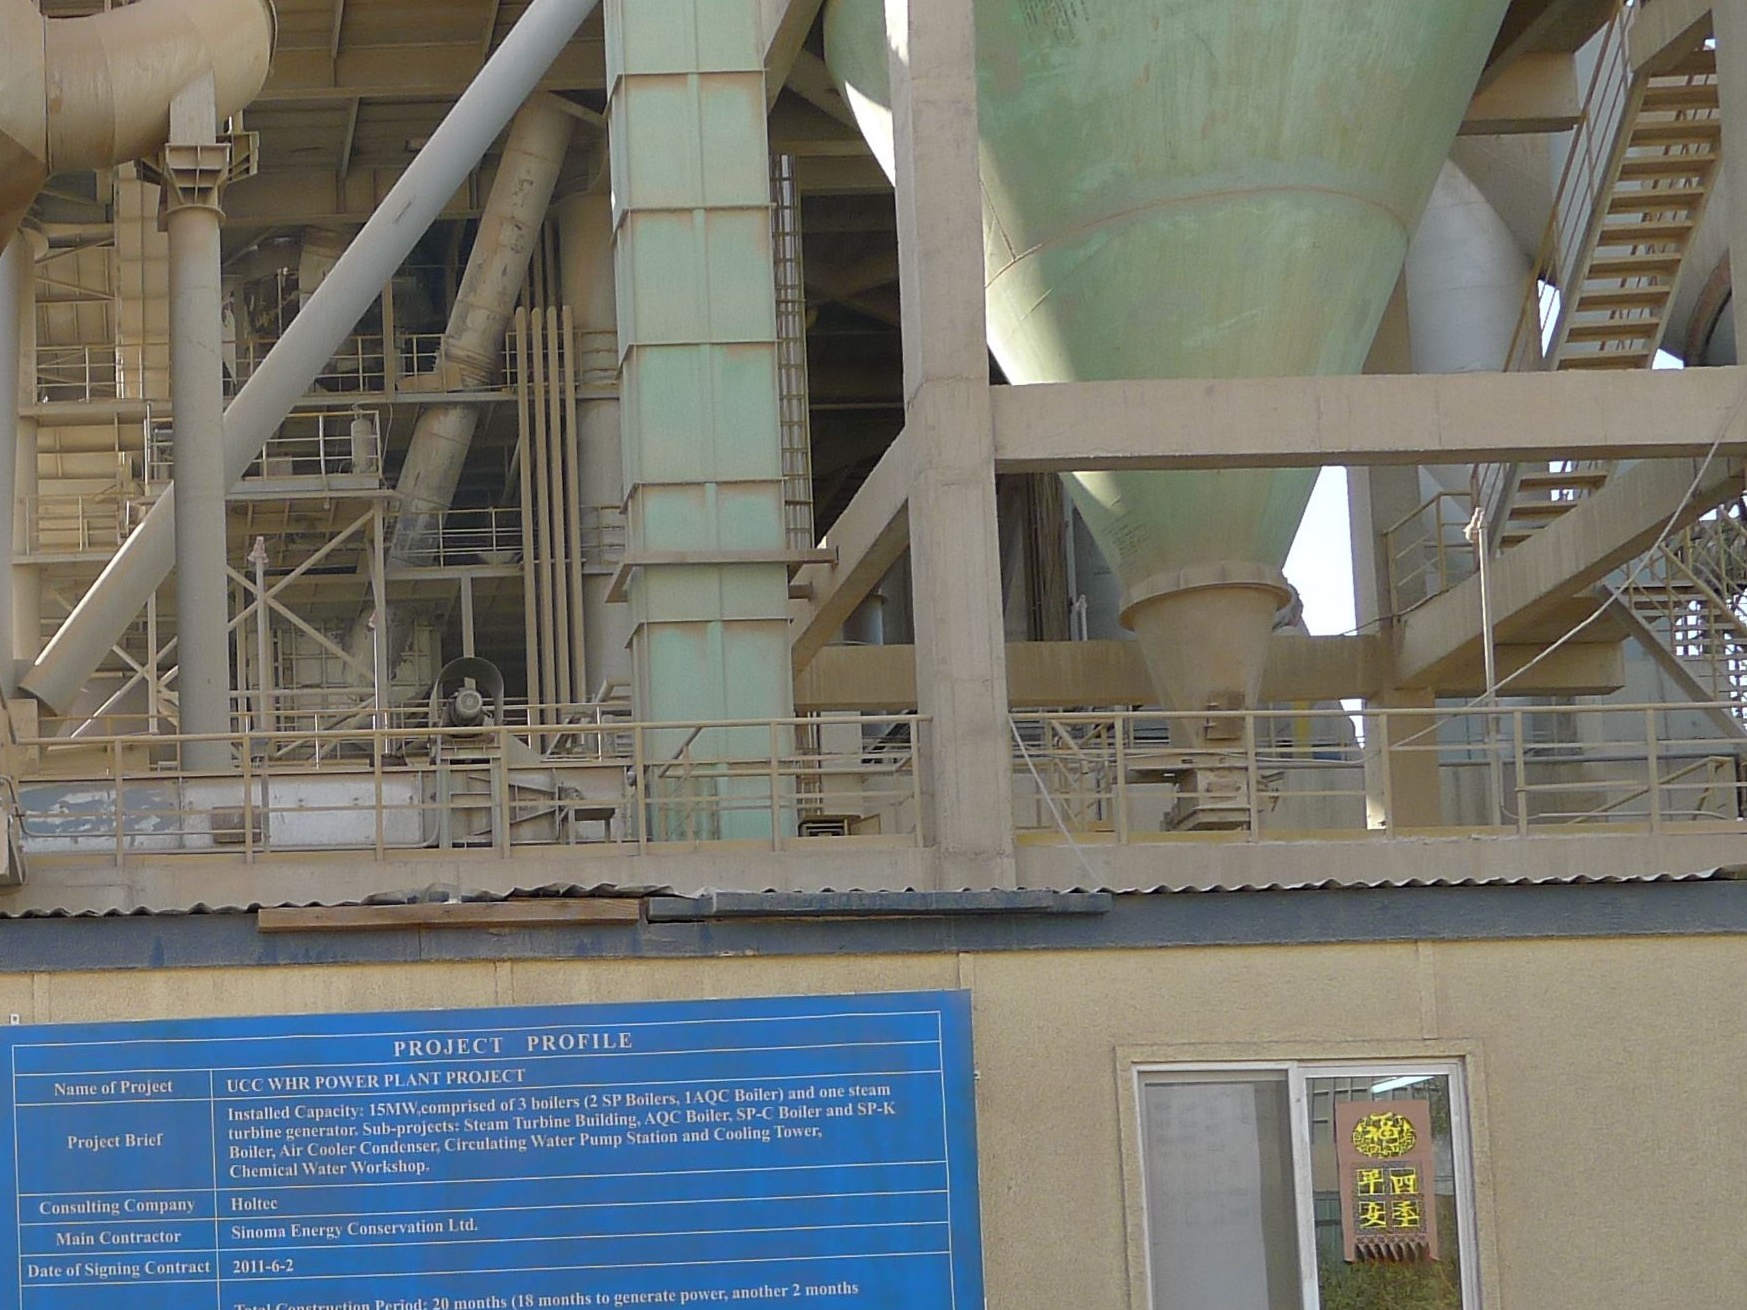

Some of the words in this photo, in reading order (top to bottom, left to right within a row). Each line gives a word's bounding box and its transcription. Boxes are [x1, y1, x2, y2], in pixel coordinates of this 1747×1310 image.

[394, 1037, 503, 1057] PROJECT
[526, 1032, 632, 1052] PROFILE
[54, 1083, 98, 1096] Name
[101, 1080, 118, 1095] of
[120, 1080, 173, 1097] Project
[226, 1078, 262, 1094] UCC
[267, 1076, 311, 1092] WHR
[315, 1074, 380, 1090] POWER
[384, 1071, 441, 1088] PLANT
[446, 1068, 526, 1085] PROJECT
[228, 1105, 290, 1121] Installed
[294, 1104, 364, 1122] Capacity:
[500, 1097, 515, 1111] of
[517, 1097, 528, 1110] 3
[531, 1095, 580, 1110] boilers
[583, 1094, 598, 1109] (2
[602, 1093, 622, 1107] SP
[625, 1092, 681, 1107] Boilers,
[734, 1087, 784, 1102] Boiler)
[788, 1085, 815, 1100] and
[819, 1087, 845, 1098] one
[848, 1085, 891, 1097] steam
[228, 1125, 282, 1140] turbine
[464, 1119, 509, 1132] Steam
[512, 1114, 571, 1130] Turbine
[574, 1112, 642, 1129] Building,
[644, 1110, 681, 1127] AQC
[686, 1108, 733, 1123] Boiler,
[736, 1106, 773, 1121] SP-C
[778, 1104, 823, 1119] Boiler
[826, 1102, 854, 1117] and
[857, 1101, 896, 1116] SP-K
[67, 1135, 121, 1152] Project
[125, 1132, 164, 1147] Brief
[229, 1145, 276, 1160] Boiler,
[280, 1143, 304, 1157] Air
[306, 1142, 357, 1157] Cooler
[444, 1135, 528, 1153] Circulating
[530, 1134, 576, 1148] Water
[579, 1132, 623, 1149] Pump
[626, 1130, 678, 1145] Station
[681, 1127, 710, 1142] and
[713, 1126, 771, 1143] Cooling
[773, 1125, 823, 1139] Tower,
[229, 1162, 298, 1179] Chemical
[301, 1162, 347, 1176] Water
[350, 1159, 430, 1176] Workshop.
[39, 1199, 121, 1216] Consulting
[123, 1198, 194, 1215] Company
[231, 1197, 278, 1211] Holtec
[56, 1232, 95, 1246] Main
[98, 1231, 182, 1245] Contractor
[231, 1225, 286, 1239] Sinoma
[290, 1223, 343, 1240] Energy
[346, 1219, 444, 1236] Conservation
[448, 1217, 478, 1232] Ltd.
[28, 1264, 63, 1278] Date
[66, 1264, 83, 1278] of
[84, 1262, 141, 1278] Signing
[144, 1260, 210, 1275] Contract
[233, 1258, 294, 1274] 2011-6-2
[432, 1297, 450, 1310] 20
[453, 1295, 508, 1310] months
[511, 1293, 534, 1310] (18
[538, 1291, 592, 1307] months
[596, 1293, 610, 1305] to
[613, 1290, 676, 1307] generate
[679, 1290, 729, 1305] power,
[732, 1284, 789, 1299] another
[792, 1283, 801, 1297] 2
[805, 1281, 859, 1296] months
